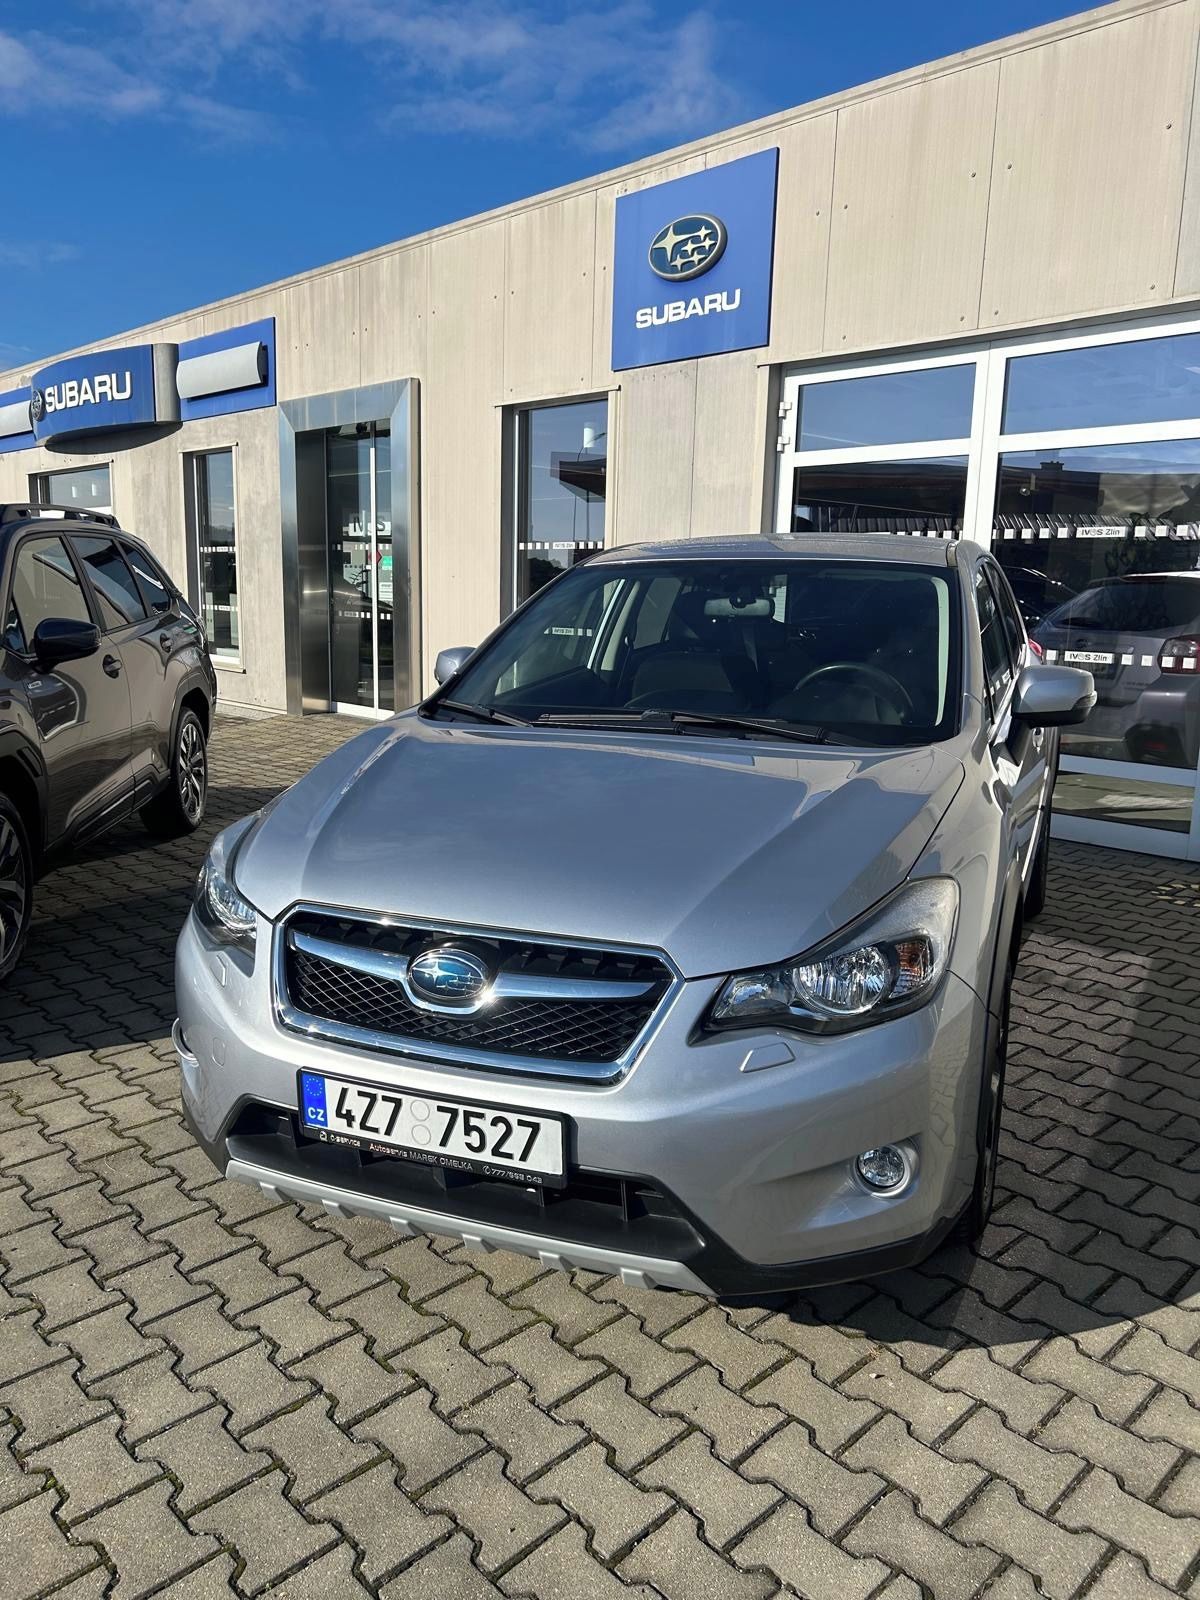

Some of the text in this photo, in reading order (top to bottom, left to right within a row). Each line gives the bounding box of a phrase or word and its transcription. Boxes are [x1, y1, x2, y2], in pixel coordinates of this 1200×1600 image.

[635, 288, 741, 329] SUBARU
[44, 371, 131, 413] SUBARU
[307, 1106, 325, 1122] CZ
[335, 1087, 542, 1162] 4Z7 7527
[369, 1143, 473, 1171] Autoservis MAREK OMELKA
